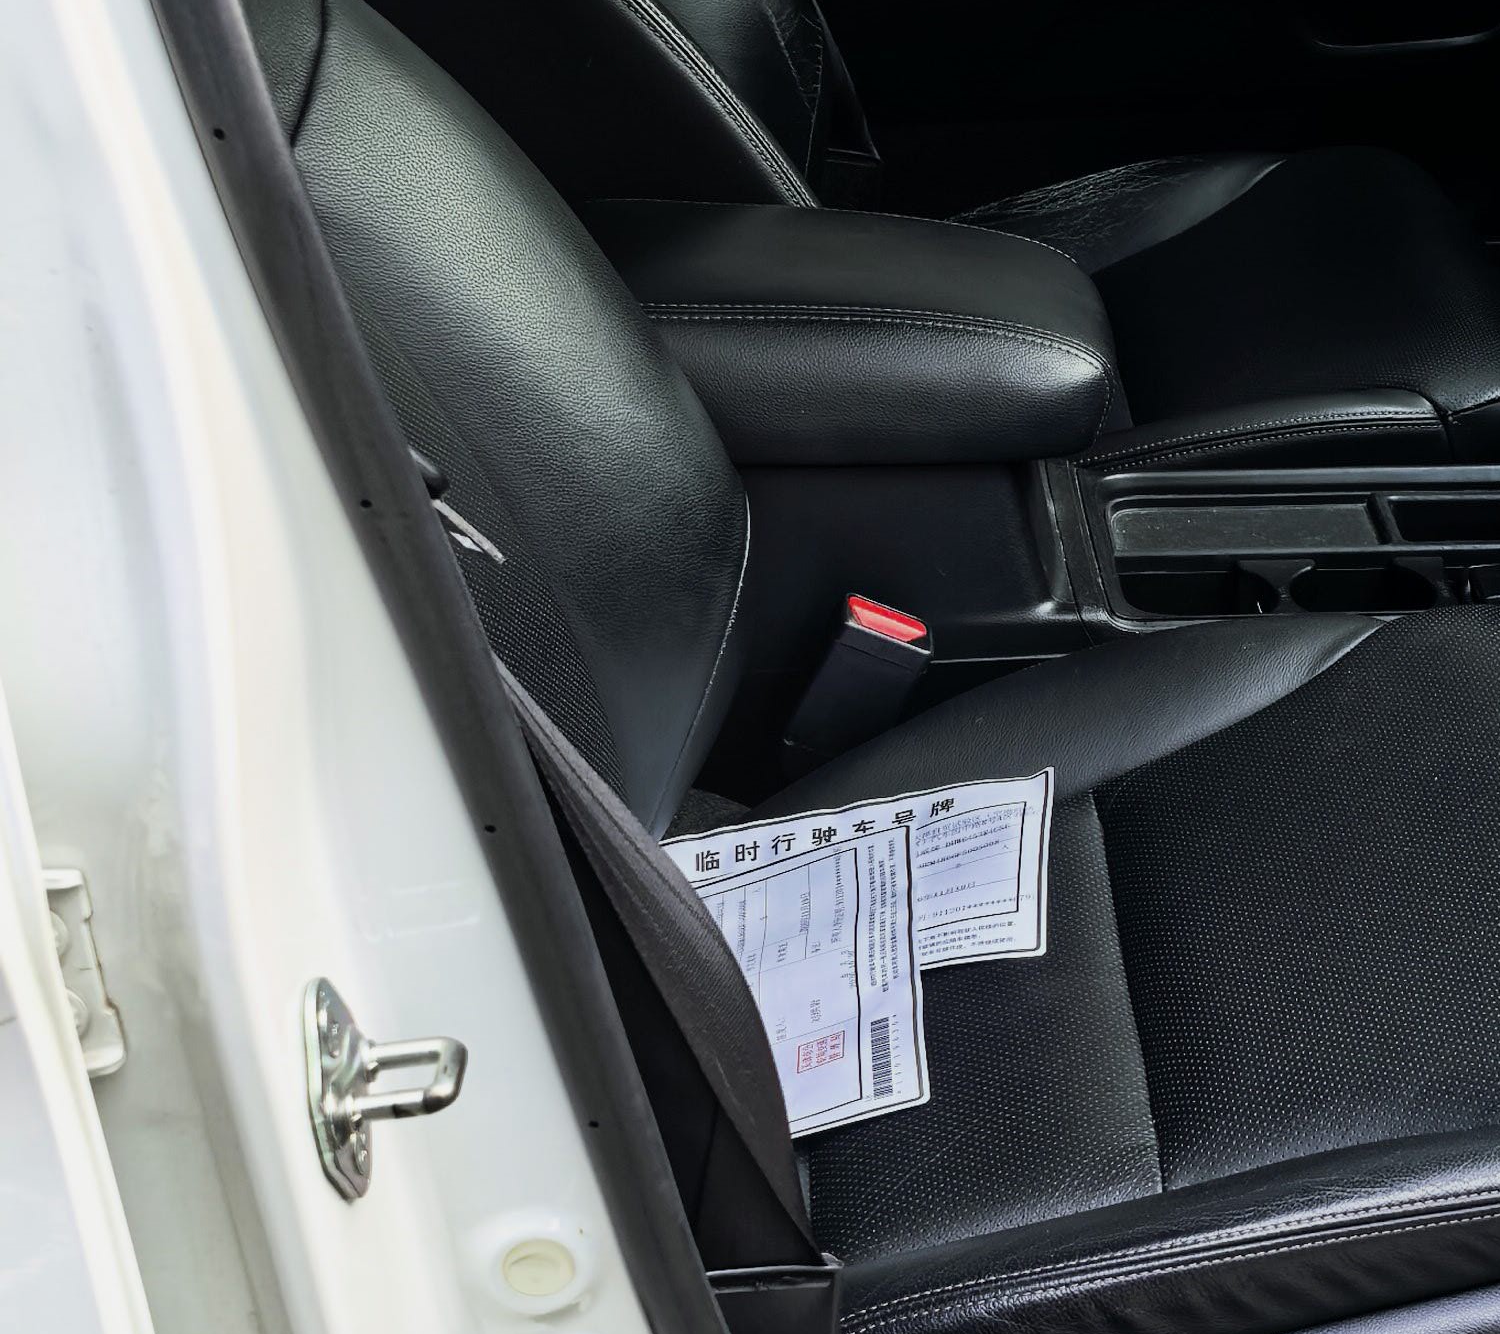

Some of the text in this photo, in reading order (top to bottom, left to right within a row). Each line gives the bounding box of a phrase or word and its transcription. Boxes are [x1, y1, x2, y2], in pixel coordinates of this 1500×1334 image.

[695, 796, 955, 873] 临时行驶车号牌
